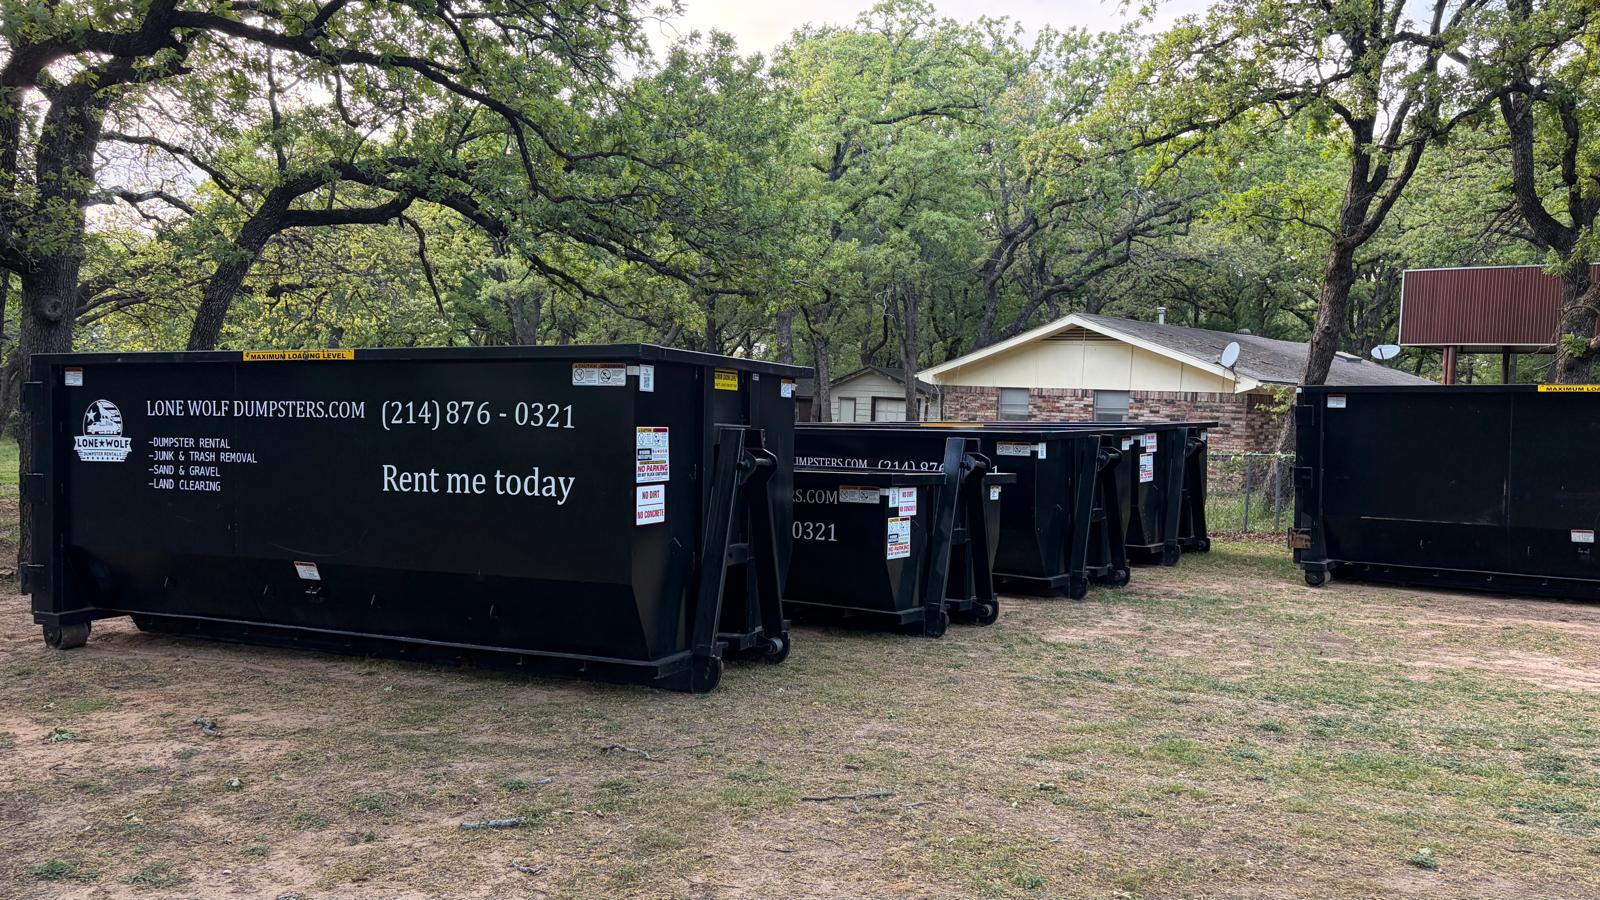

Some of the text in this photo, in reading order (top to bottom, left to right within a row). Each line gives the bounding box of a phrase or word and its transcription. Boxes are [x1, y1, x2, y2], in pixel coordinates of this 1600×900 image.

[147, 400, 365, 418] LONE WOLF DUMPSTERS.COM
[515, 402, 575, 429] 0321
[77, 439, 129, 448] LONE WOLF
[199, 438, 231, 449] RENTAL
[178, 451, 185, 461] &
[189, 451, 216, 462] TRASH
[220, 452, 258, 464] REMOVAL
[178, 465, 185, 476] &
[189, 466, 221, 477] GRAVEL
[179, 480, 221, 491] CLEARING
[382, 464, 575, 505] Rent me today
[650, 491, 659, 499] DIRT
[638, 509, 664, 519] NO CONCRETE
[792, 521, 837, 541] 0321
